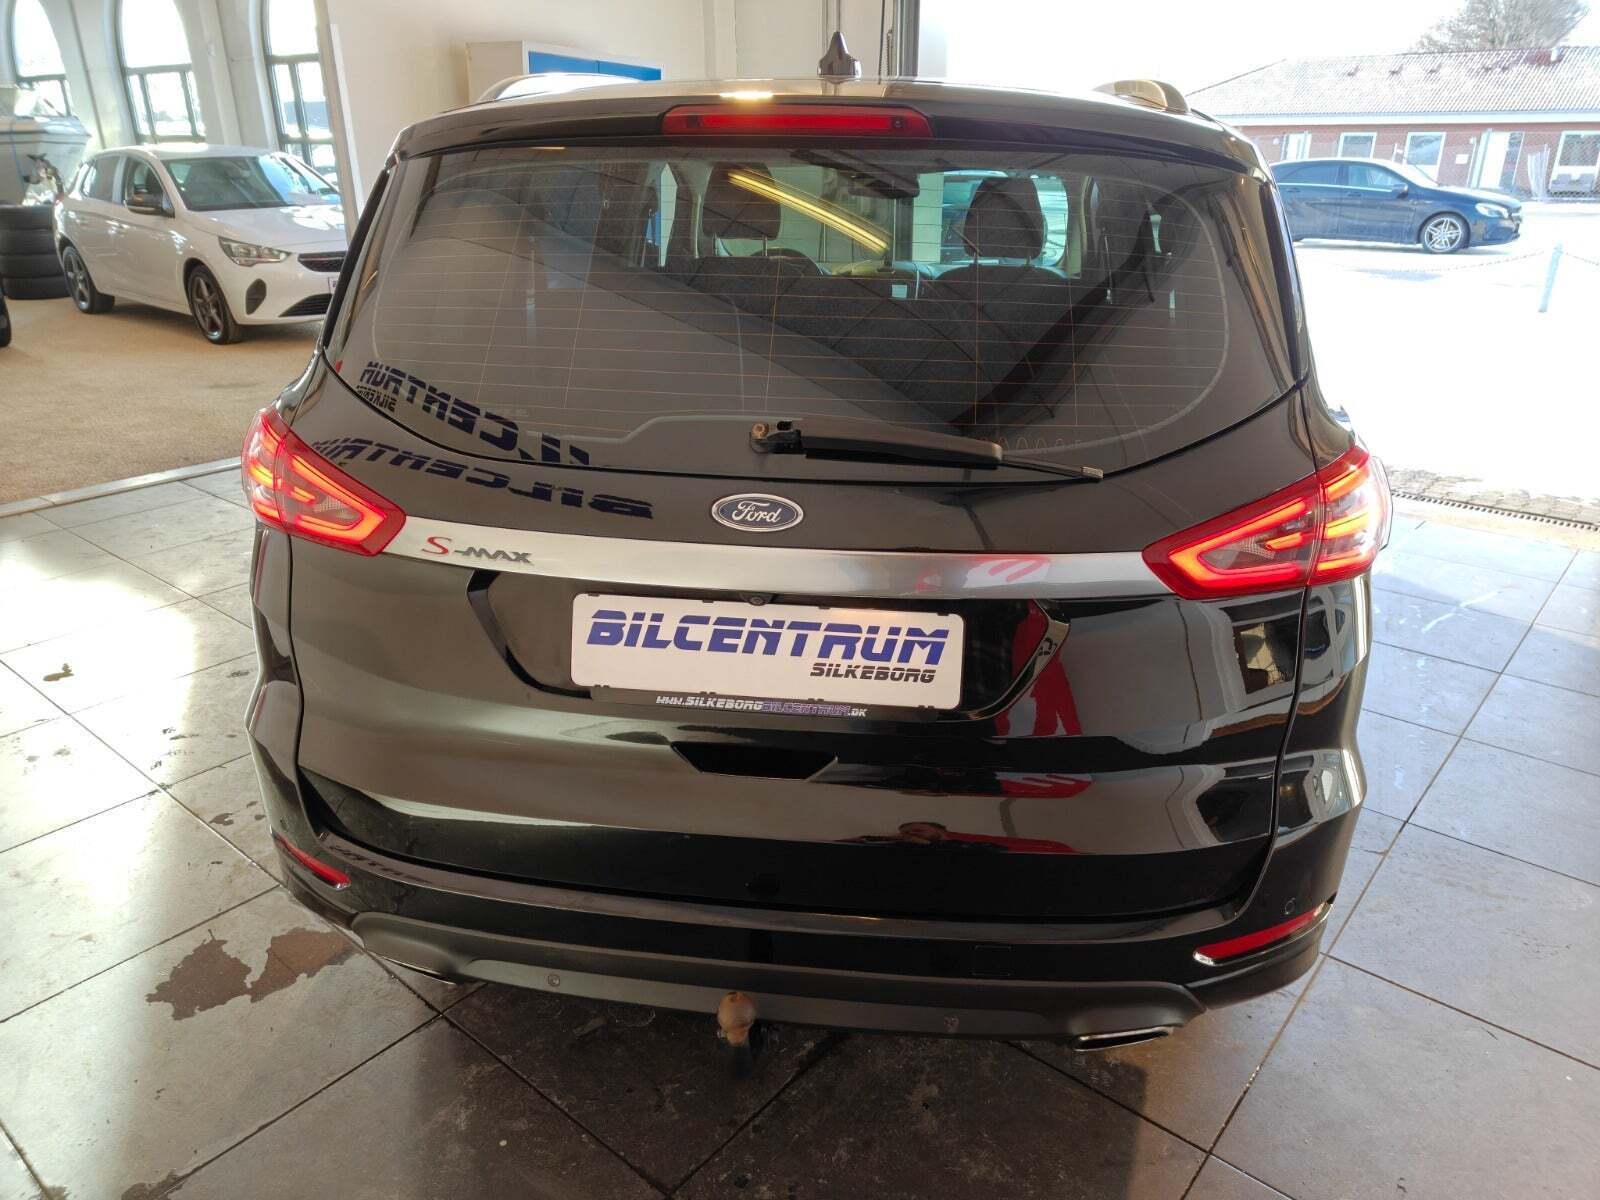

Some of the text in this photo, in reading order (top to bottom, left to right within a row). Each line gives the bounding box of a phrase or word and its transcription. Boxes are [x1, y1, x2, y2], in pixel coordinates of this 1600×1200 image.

[732, 501, 781, 522] Ford
[421, 536, 534, 565] S-MAX
[586, 609, 950, 665] BILCENTRUM
[810, 662, 936, 684] SILKEBORG
